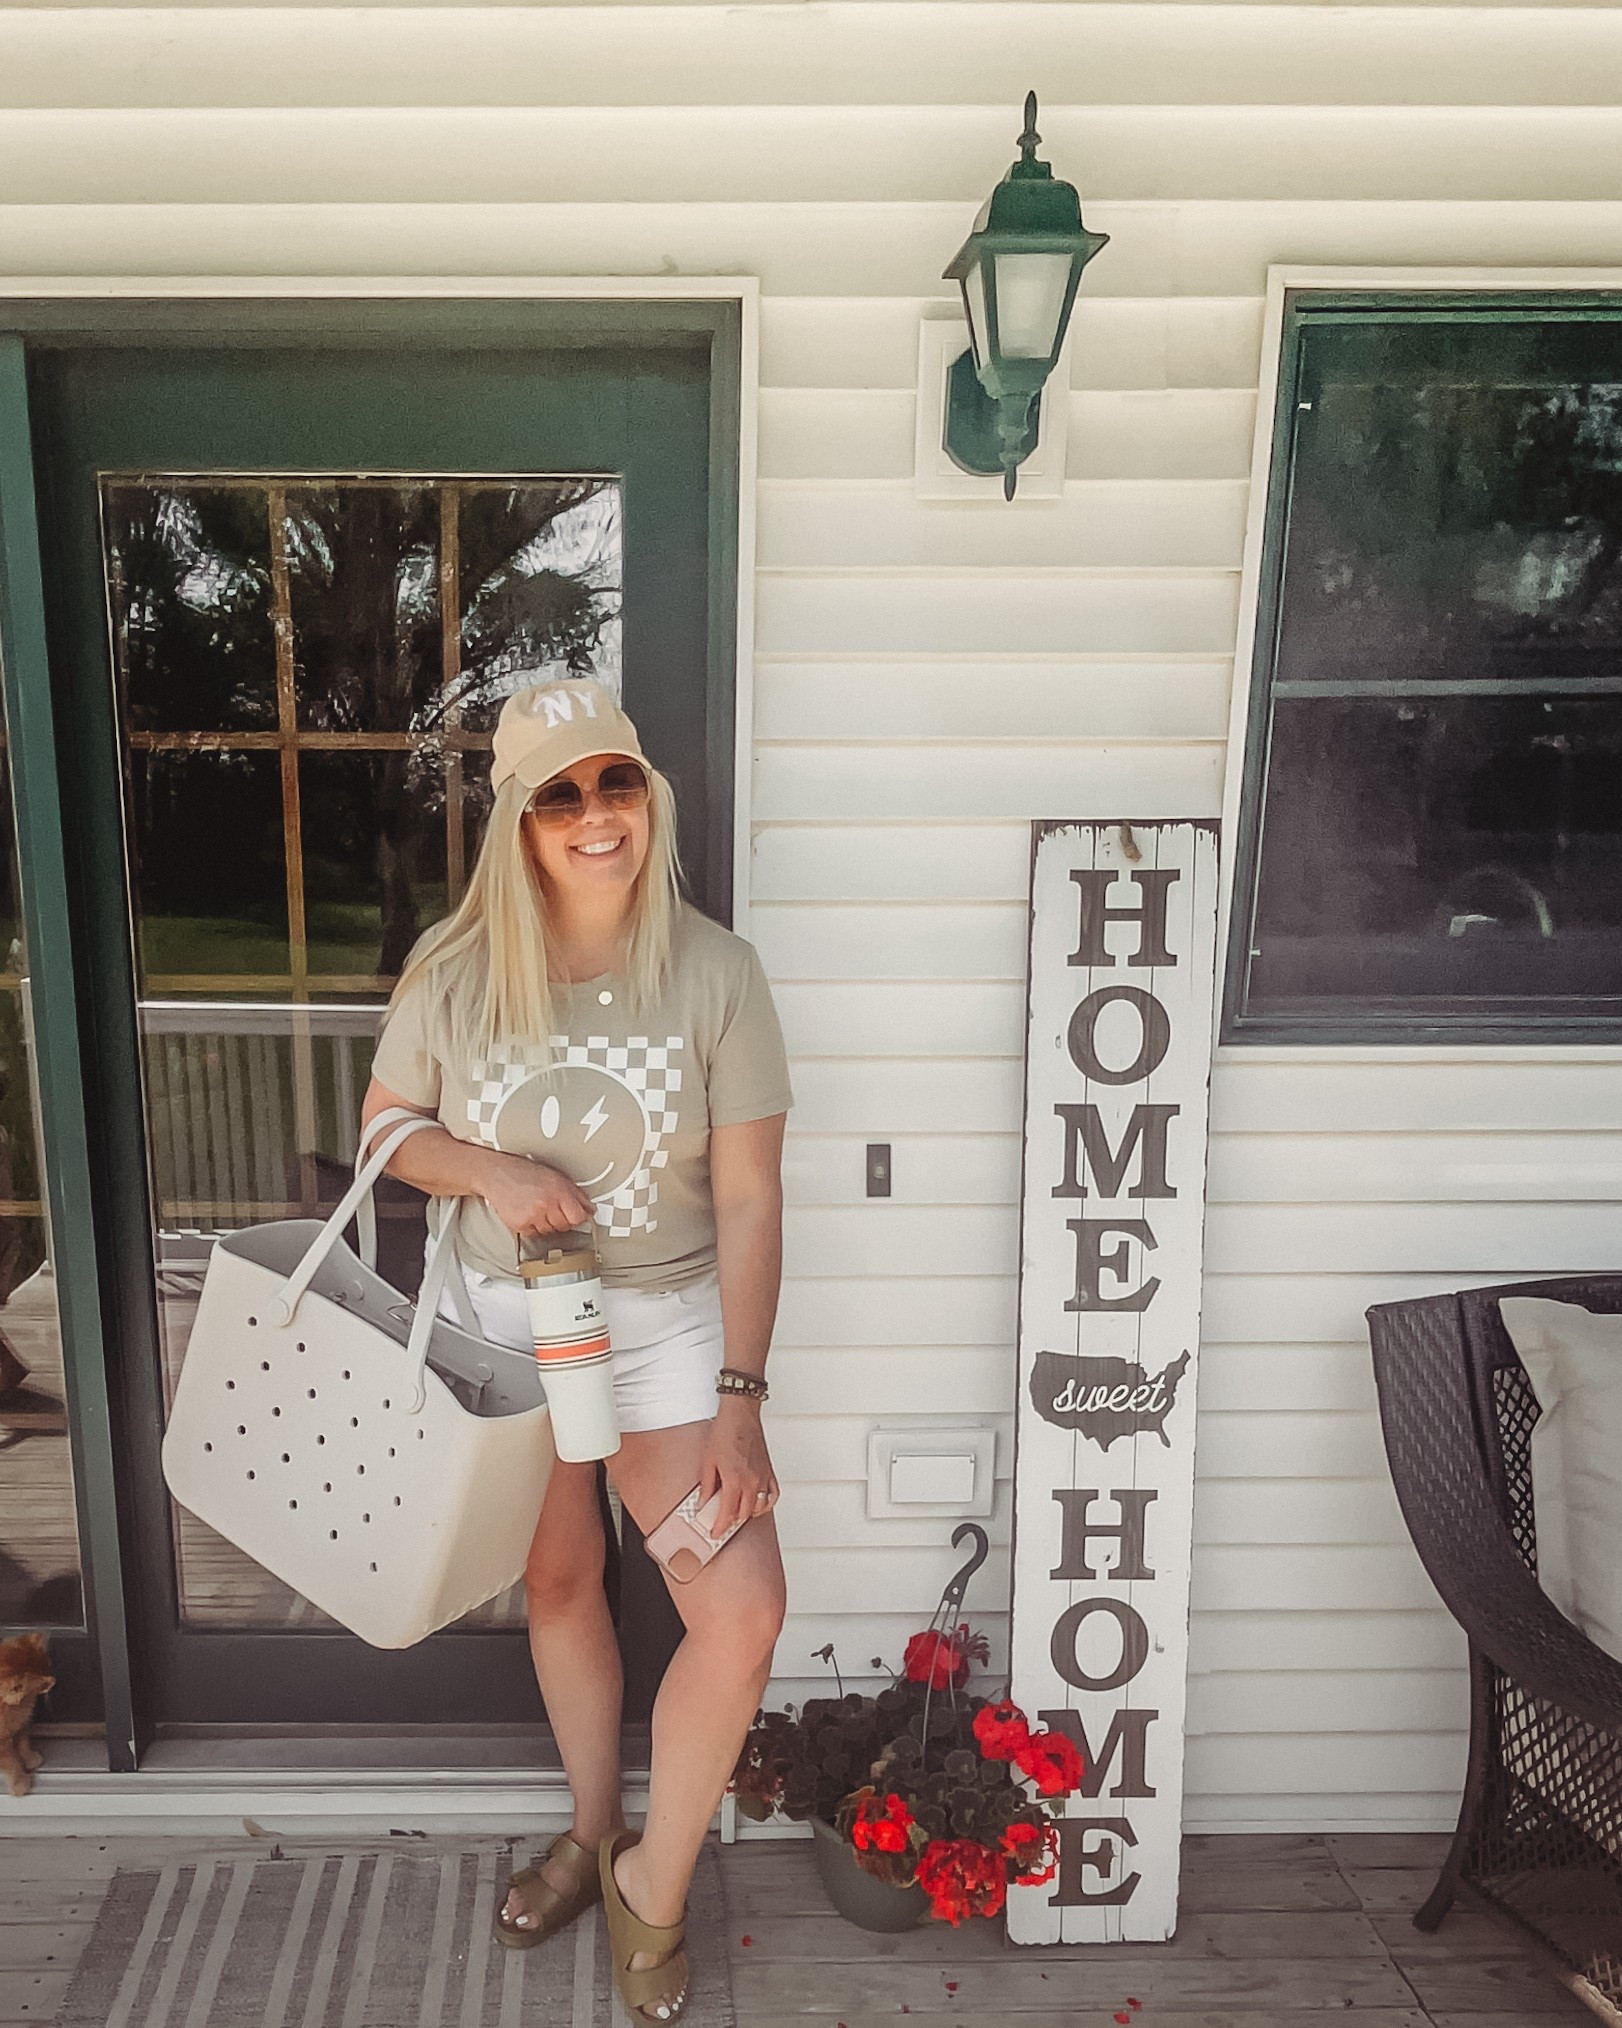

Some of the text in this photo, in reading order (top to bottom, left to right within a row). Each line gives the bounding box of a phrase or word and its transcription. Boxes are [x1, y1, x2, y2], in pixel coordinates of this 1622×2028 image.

[532, 689, 597, 728] NY
[1051, 869, 1181, 1312] HOME
[1053, 1375, 1167, 1413] sweet
[1035, 1489, 1159, 1907] HOME
